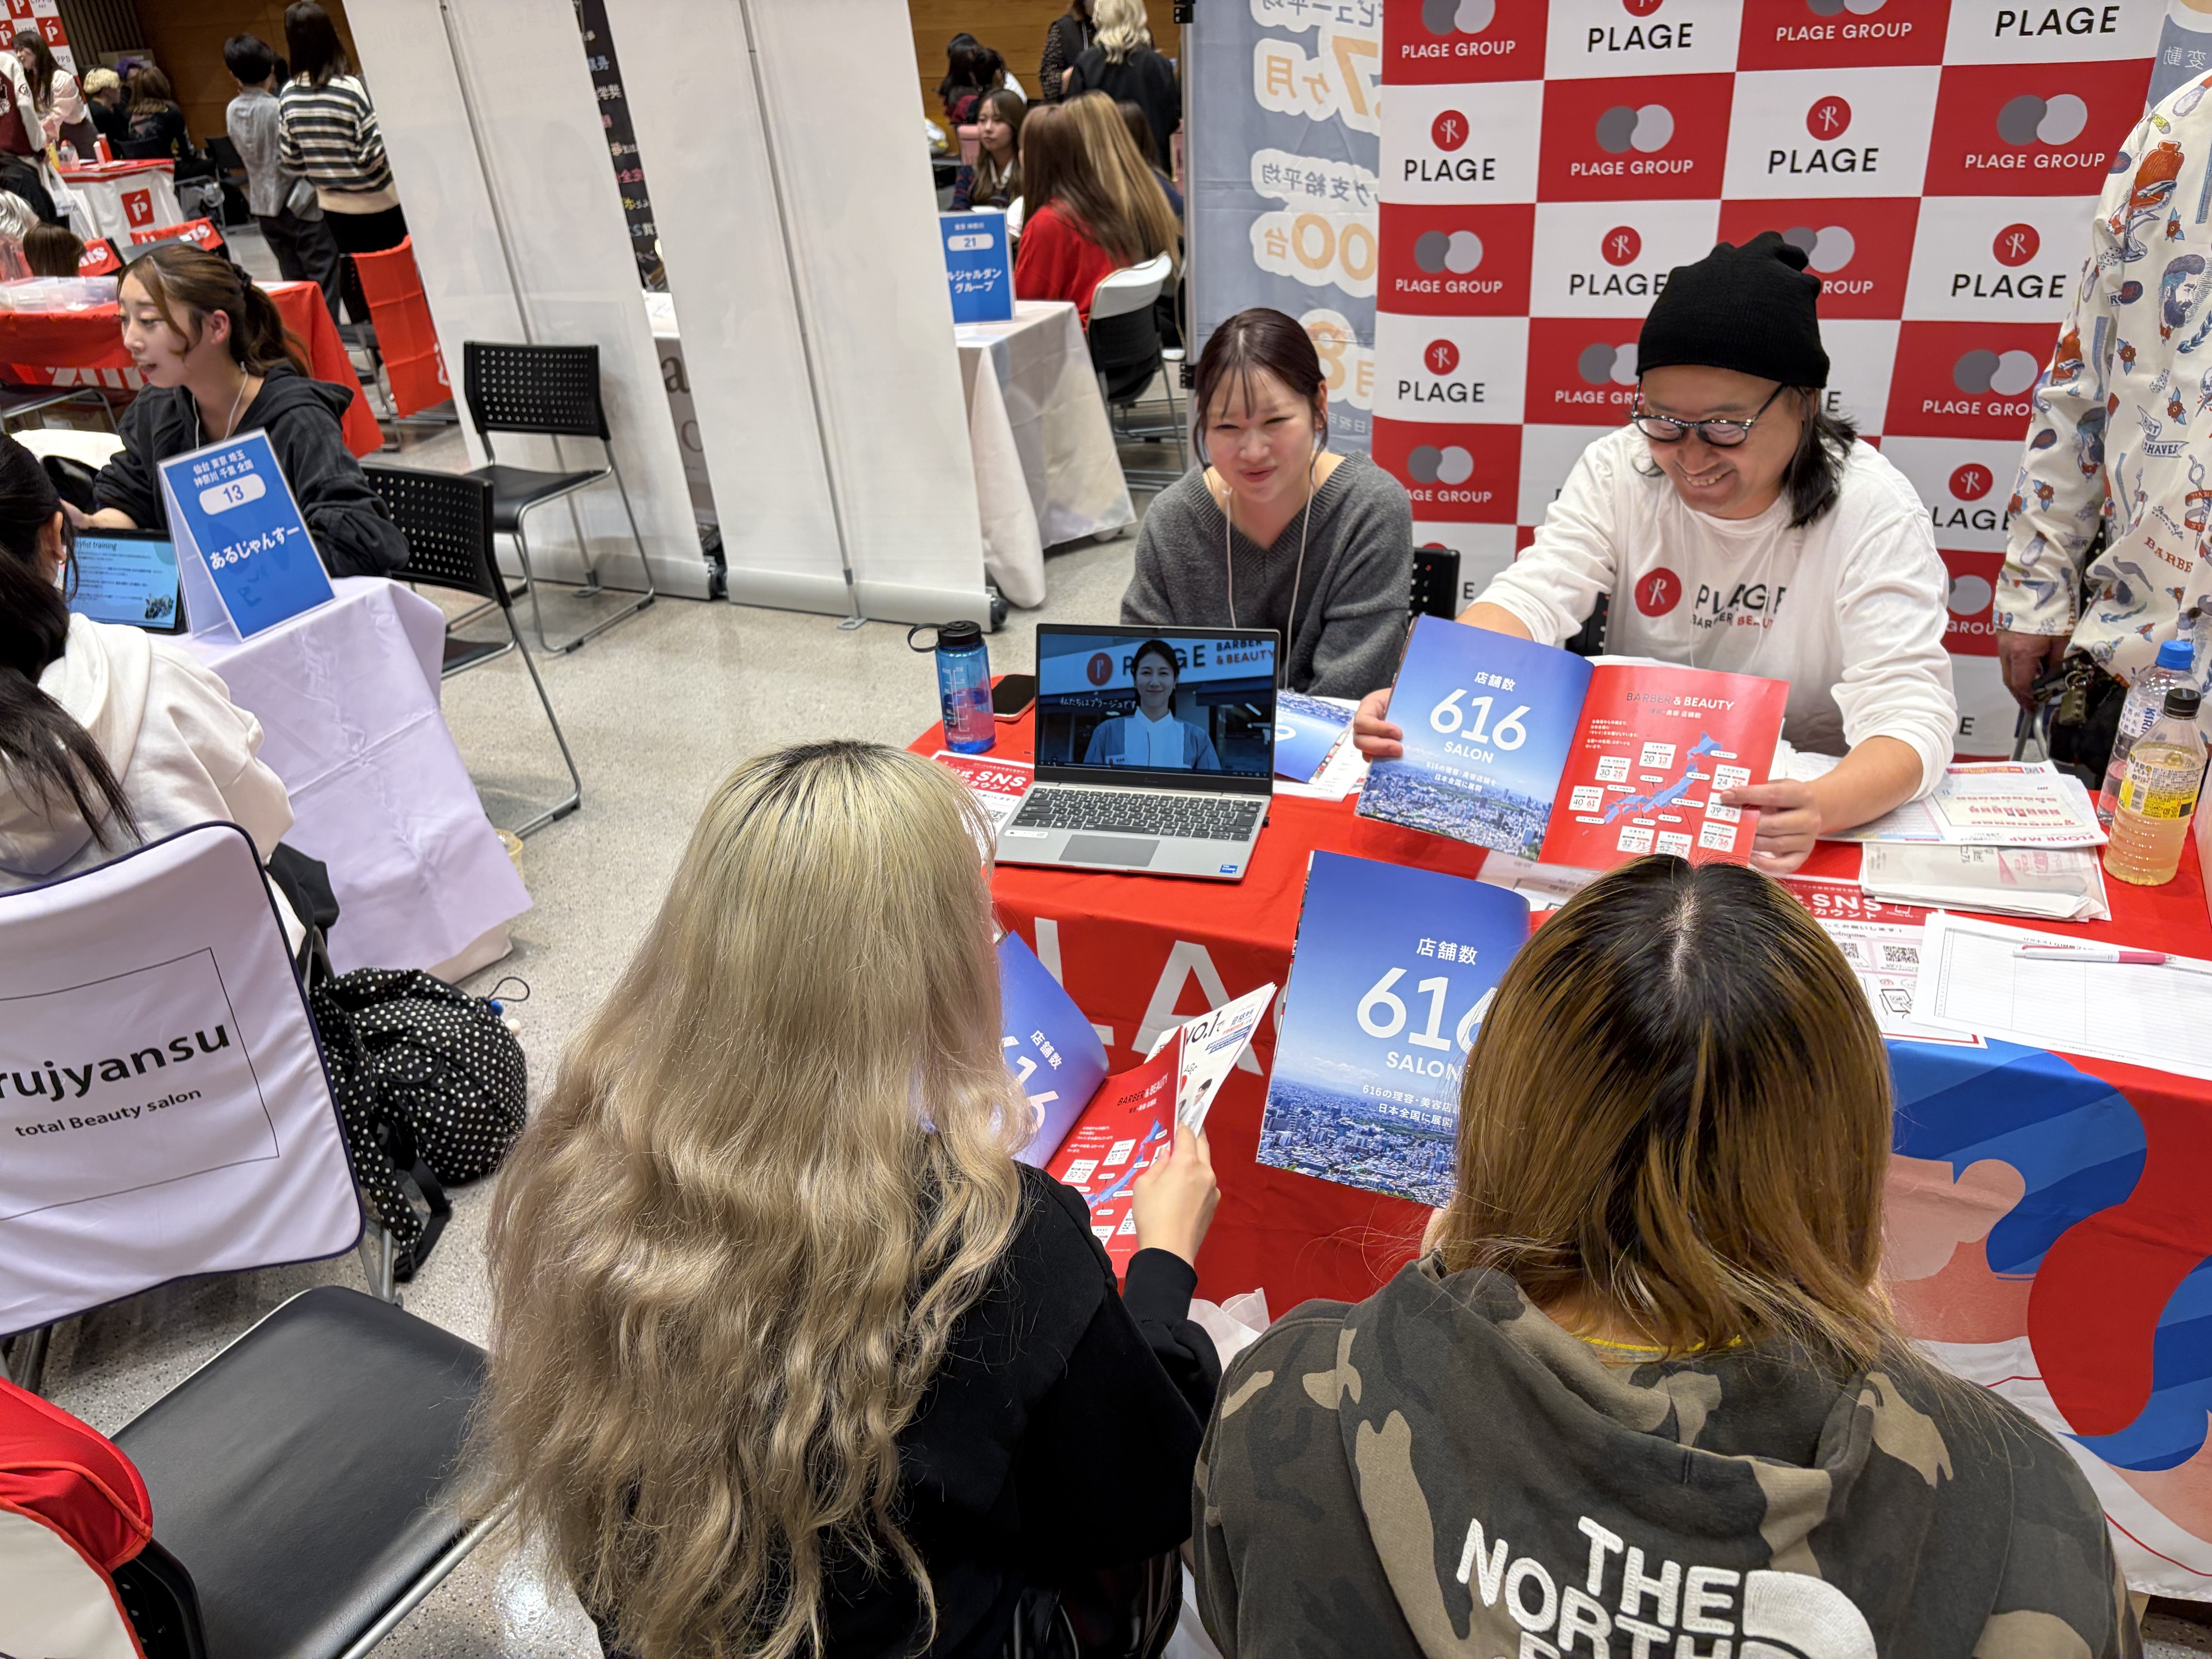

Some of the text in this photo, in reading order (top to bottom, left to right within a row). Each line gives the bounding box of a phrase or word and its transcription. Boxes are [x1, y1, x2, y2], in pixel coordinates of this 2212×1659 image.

[1995, 6, 2120, 37] PLAGE
[1588, 23, 1693, 52] PLAGE
[1776, 23, 1912, 41] PLAGE GROUP
[1402, 41, 1516, 58] PLAGE GROUP
[1404, 158, 1495, 182] PLAGE
[1571, 160, 1693, 176] PLAGE GROUP
[1768, 148, 1879, 173] PLAGE
[1965, 153, 2105, 168] PLAGE GROUP
[964, 237, 977, 248] 21
[1396, 279, 1502, 294] PLAGE GROUP
[1569, 273, 1668, 296] PLAGE
[1821, 280, 1873, 294] ROUP
[1951, 273, 2067, 298] PLAGE
[1398, 380, 1485, 403] PLAGE
[1555, 390, 1645, 404] PLAGE GRO
[1922, 400, 2030, 417] PLAGE GRO
[211, 455, 228, 469] 東京
[228, 449, 246, 463] 埼玉
[194, 459, 255, 488] 神奈川 千葉 全国
[223, 484, 244, 503] 13
[1438, 491, 1493, 503] GROUP
[1933, 506, 2010, 531] LAG
[93, 541, 117, 551] training
[210, 526, 300, 571] あるじゃんすー
[2144, 536, 2194, 573] BARBE
[1946, 621, 1998, 637] GROU
[1217, 640, 1262, 651] BARBER
[1123, 644, 1206, 676] PGE
[1227, 649, 1274, 664] BEAUTY
[1474, 672, 1516, 692] 店舗数
[1626, 693, 1735, 711] BARBER & BEAUTY
[1430, 689, 1531, 751] 616
[1444, 741, 1494, 763] SALON
[1643, 755, 1668, 764] 20 13
[976, 771, 1027, 787] SNS
[1613, 770, 1623, 778] 25
[964, 779, 1011, 792] カウント
[1812, 893, 1883, 912] SNS
[1810, 906, 1877, 920] カウント
[1416, 937, 1478, 966] 店舗数
[1031, 1030, 1062, 1070] 店舗数
[1386, 1051, 1464, 1083] SALON
[1001, 1036, 1060, 1134] 16
[1117, 1090, 1146, 1106] BARBER
[1363, 1084, 1460, 1115] 616の理容・美容店
[15, 1088, 202, 1137] total Beauty salon
[1378, 1103, 1453, 1128] 日本全国に展開
[1578, 1516, 1740, 1636] THE
